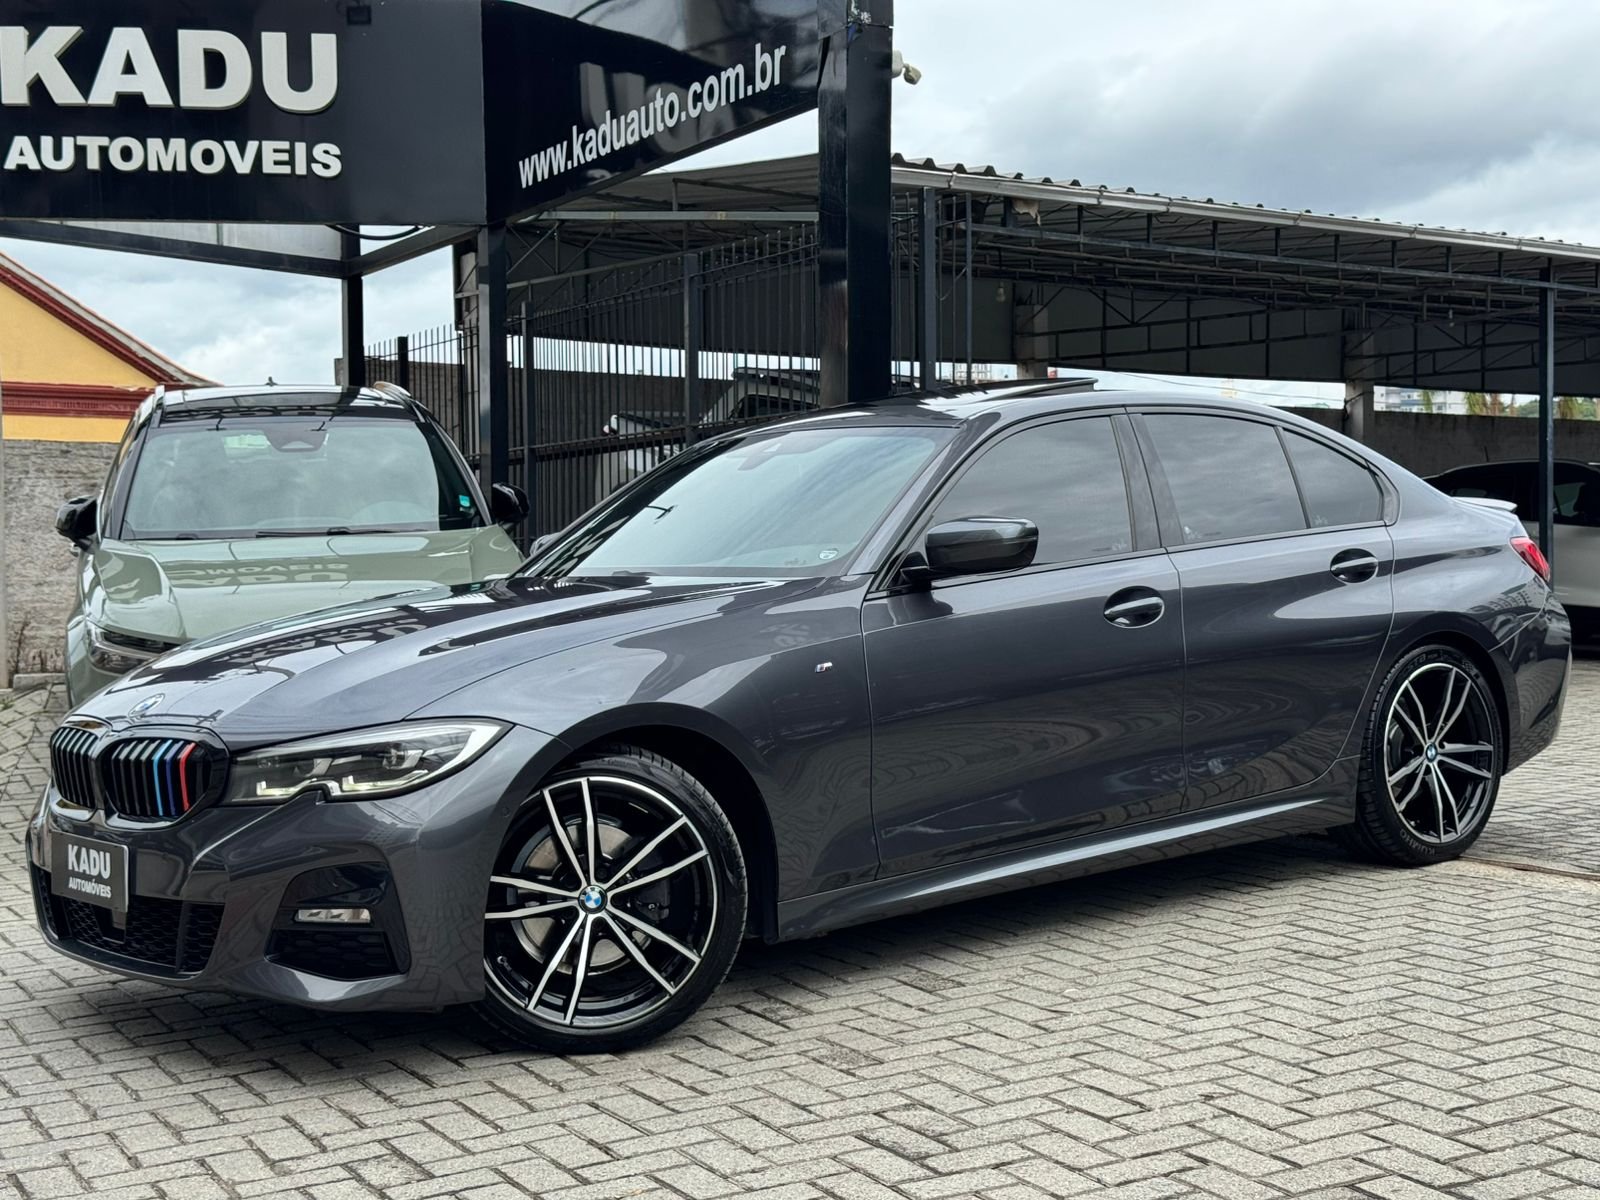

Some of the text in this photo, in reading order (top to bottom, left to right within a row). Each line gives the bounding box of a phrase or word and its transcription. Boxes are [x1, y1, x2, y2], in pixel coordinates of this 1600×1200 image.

[0, 26, 338, 114] KADU
[518, 42, 787, 189] www.kaduauto.com.br
[3, 135, 342, 178] AUTOMOVEIS
[67, 843, 111, 880] KADU
[68, 876, 112, 899] AUTOMÓVEIS
